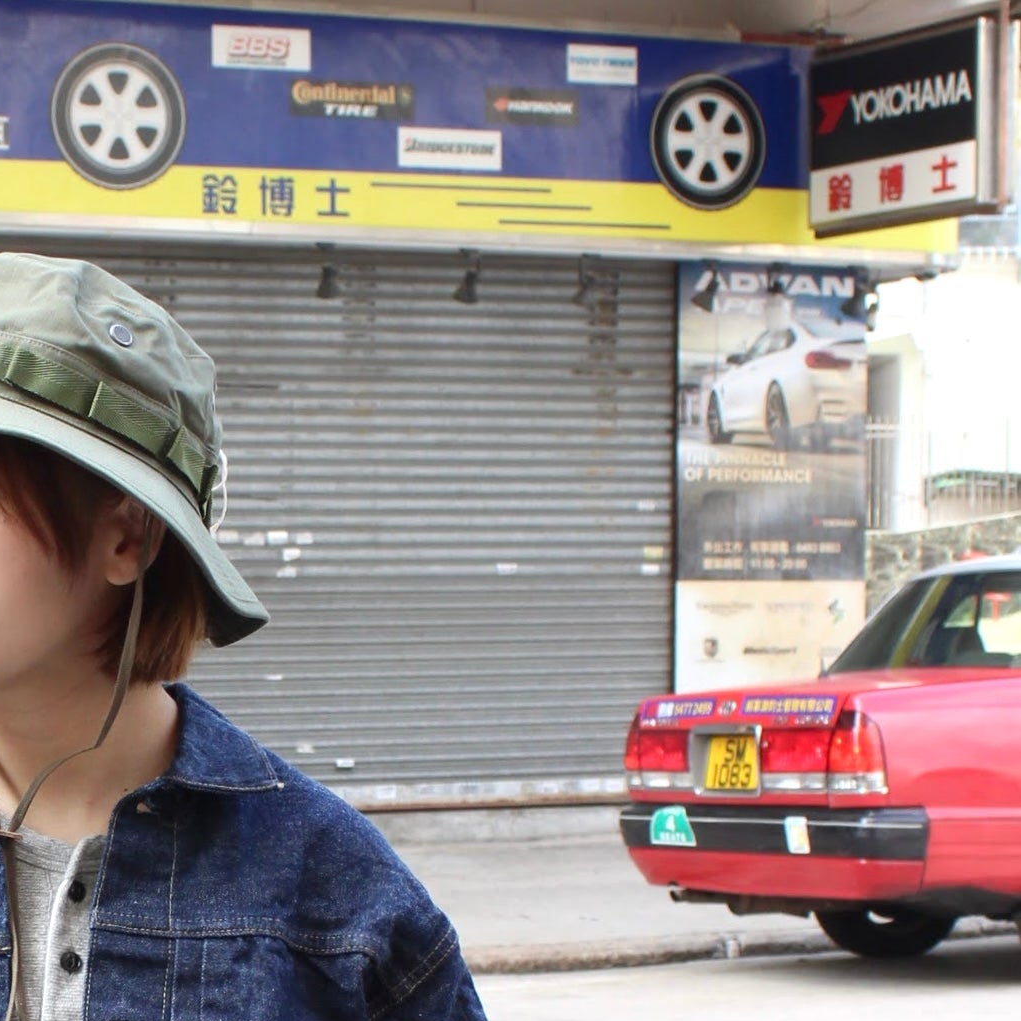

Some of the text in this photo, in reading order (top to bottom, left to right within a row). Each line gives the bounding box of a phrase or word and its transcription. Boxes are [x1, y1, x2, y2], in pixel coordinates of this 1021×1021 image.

[227, 36, 291, 60] BBS
[849, 68, 973, 126] YOKOHAMA
[323, 103, 379, 118] TIRE
[202, 173, 351, 218] 鈴博士
[684, 467, 812, 484] OF PERFORMANCE
[712, 763, 752, 787] 1083
